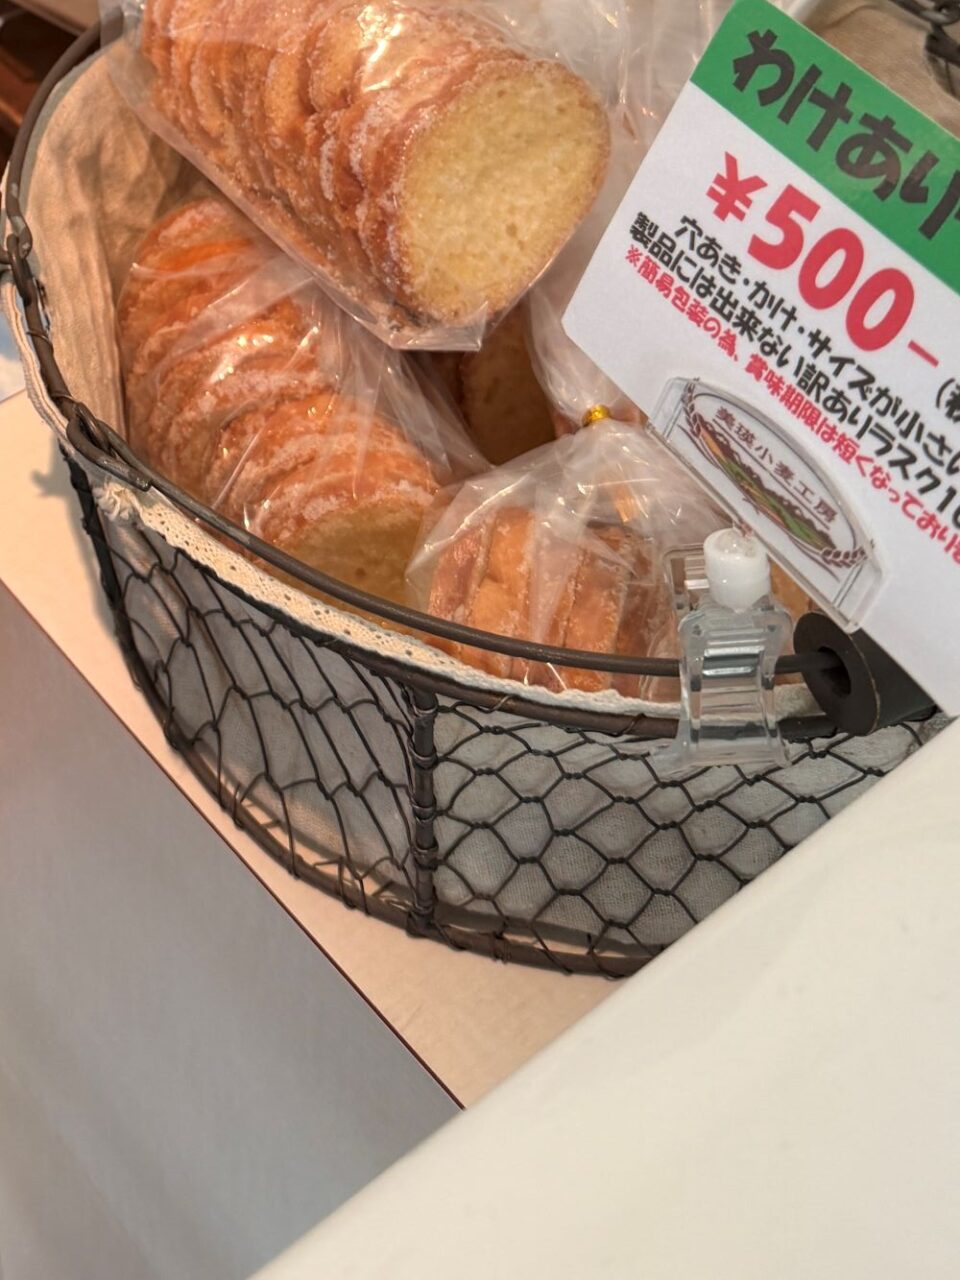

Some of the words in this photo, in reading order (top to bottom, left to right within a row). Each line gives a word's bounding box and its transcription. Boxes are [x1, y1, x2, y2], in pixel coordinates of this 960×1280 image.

[731, 27, 960, 241] わけあり
[713, 404, 840, 526] 美瑛小麦工房
